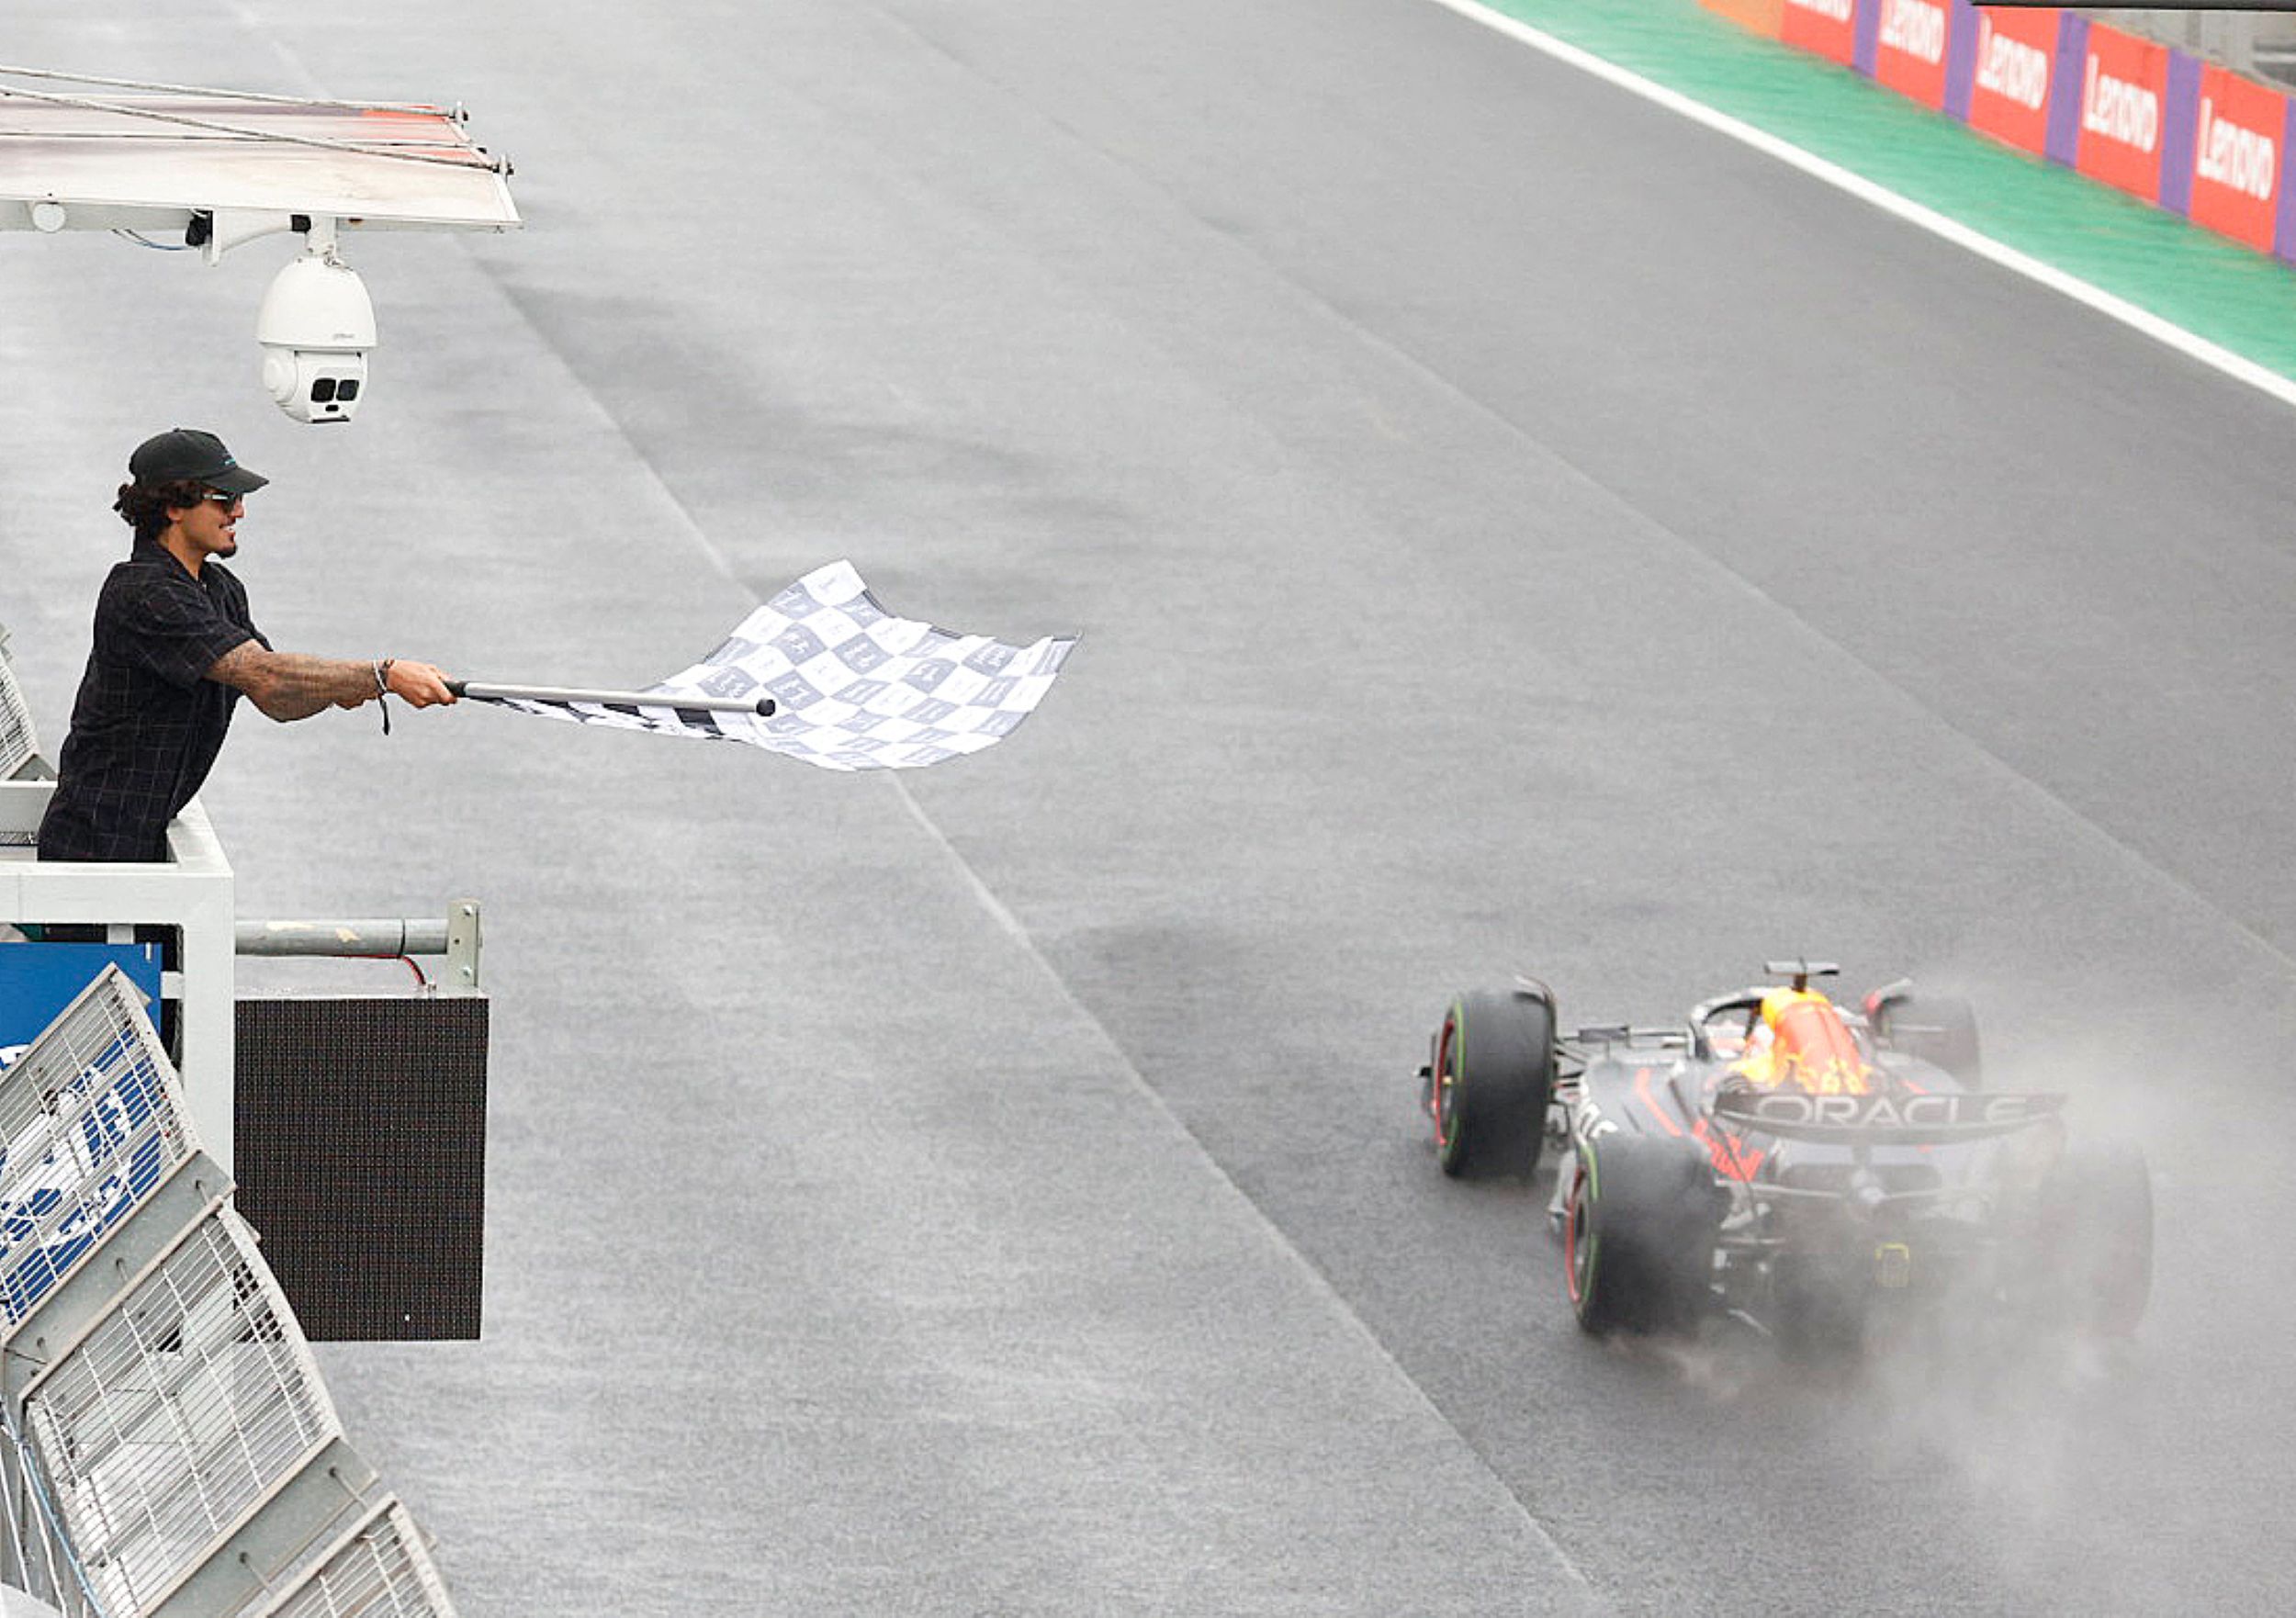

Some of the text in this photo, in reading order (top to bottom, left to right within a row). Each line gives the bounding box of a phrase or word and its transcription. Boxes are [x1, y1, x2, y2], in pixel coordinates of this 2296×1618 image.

[1976, 14, 2047, 110] Lenovo
[2083, 53, 2158, 152] Lenovo
[2197, 97, 2275, 200] Lenovo
[1755, 1095, 2027, 1128] ORACLE
